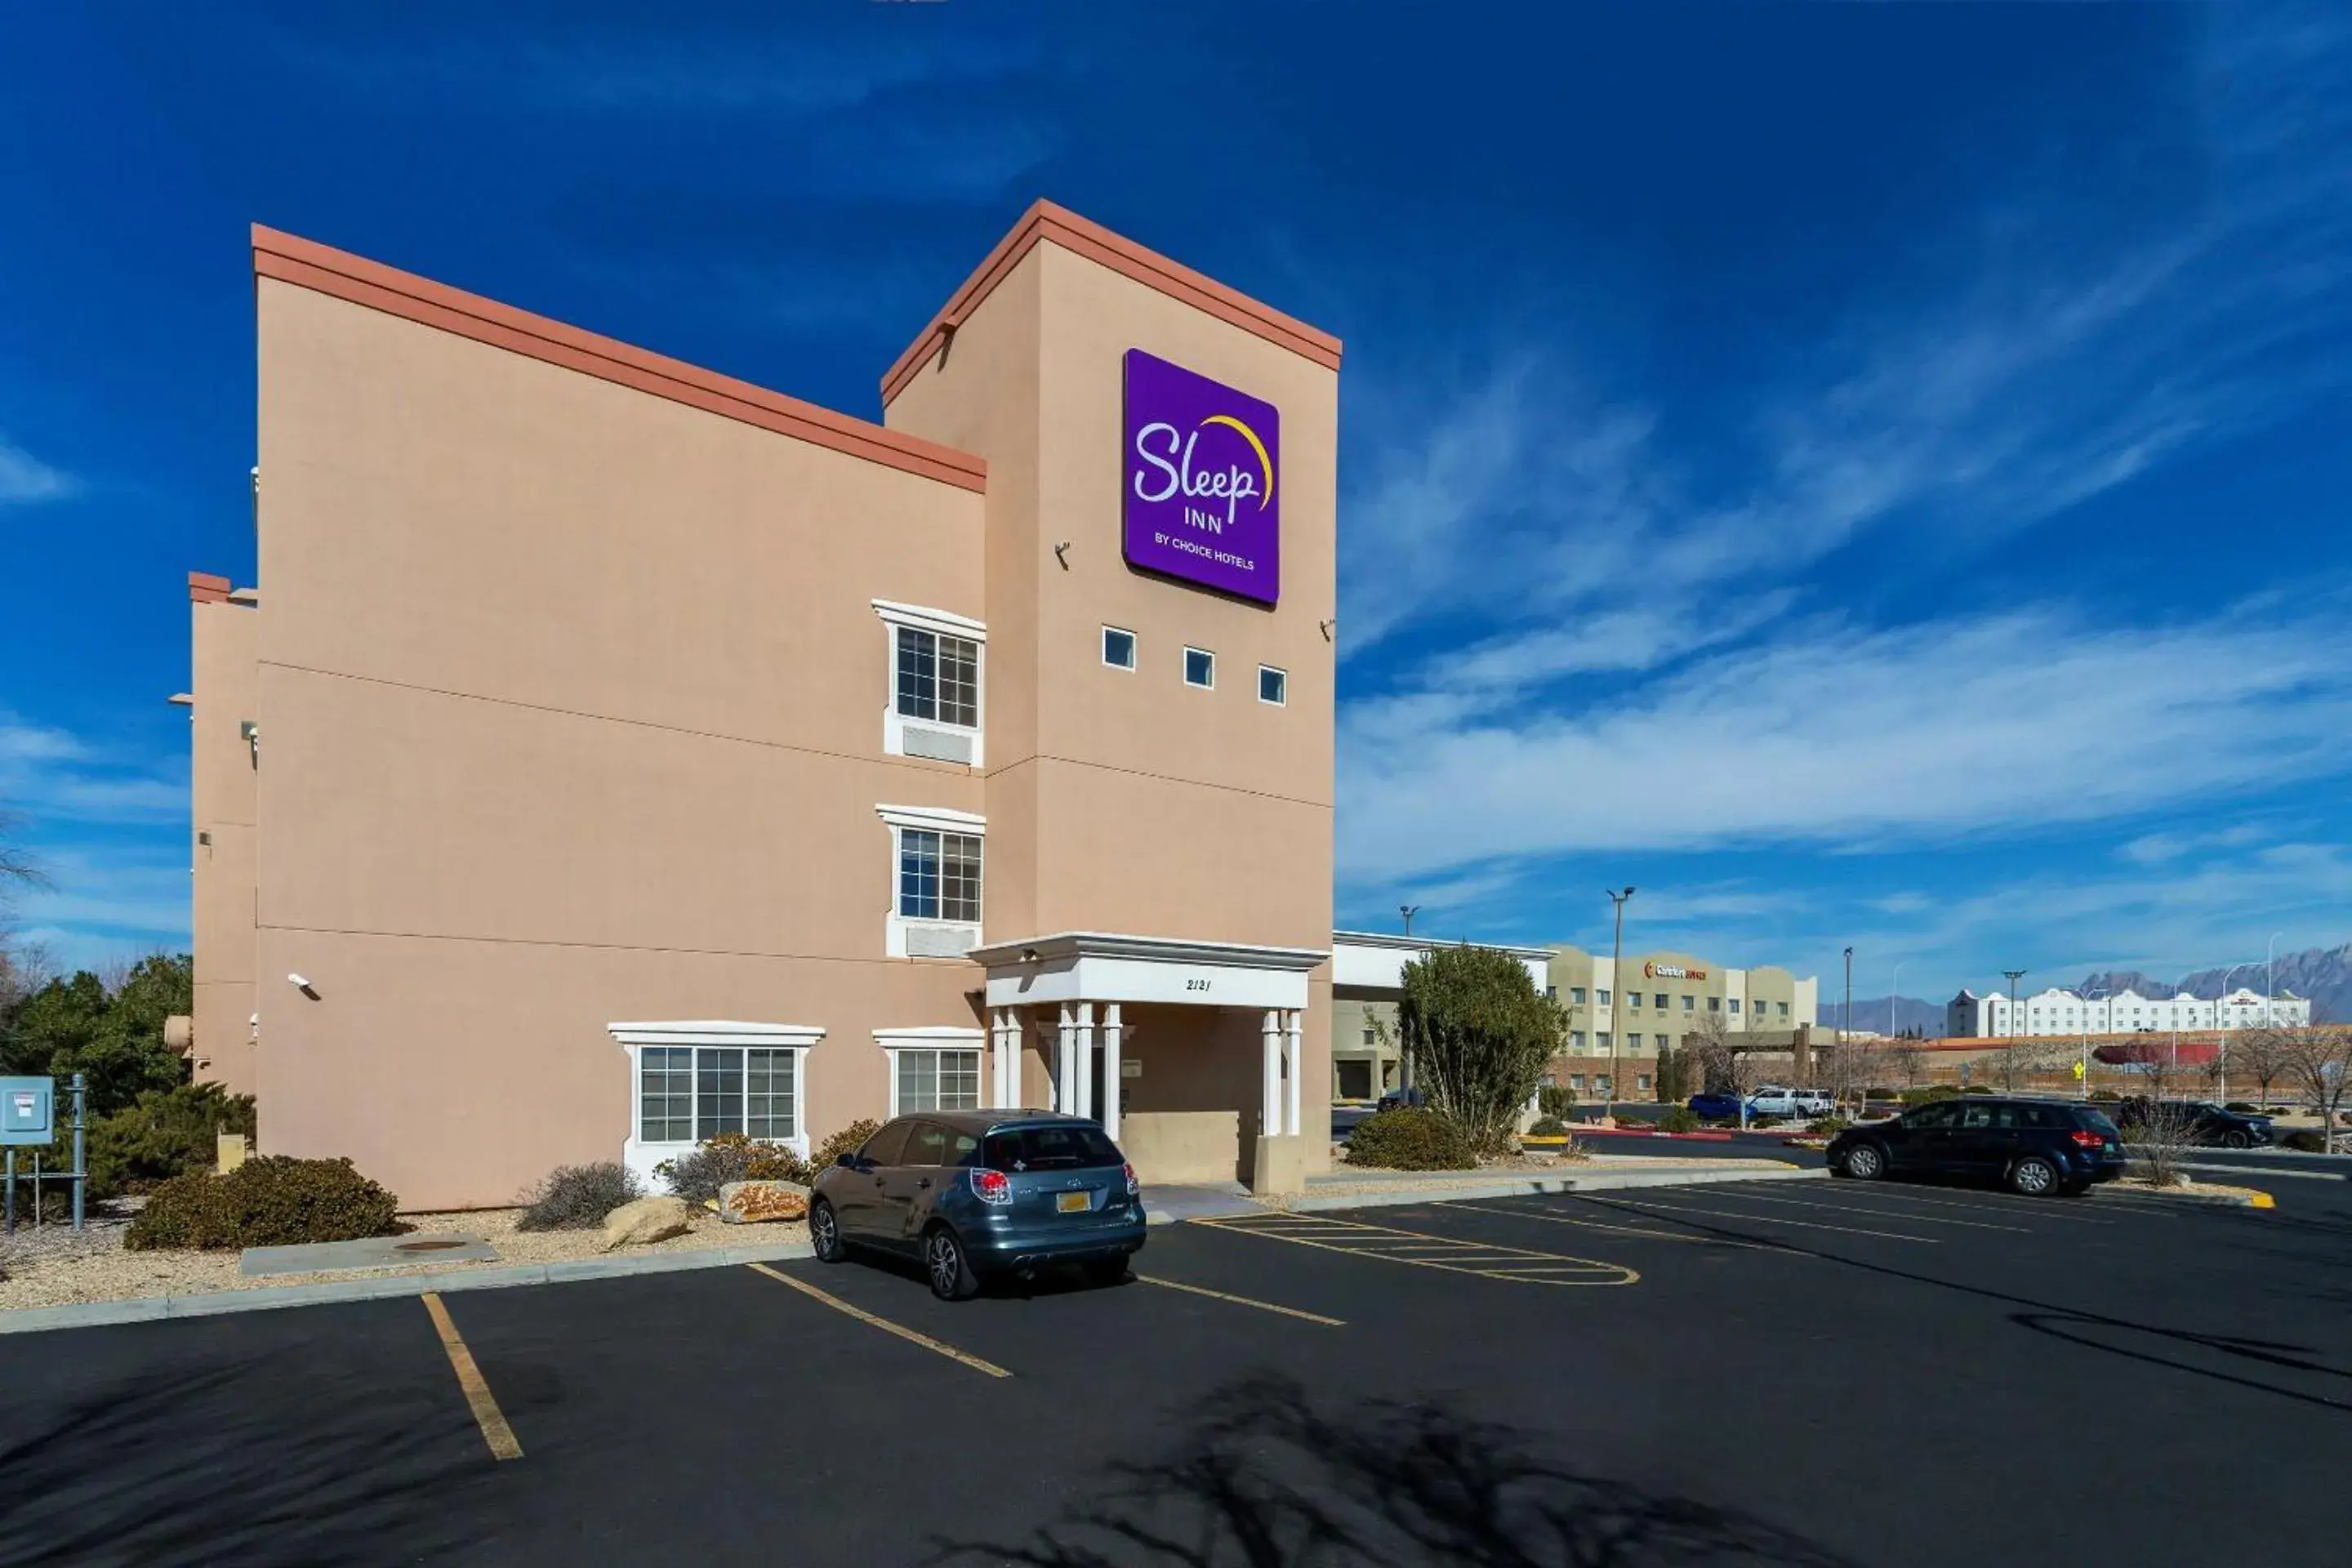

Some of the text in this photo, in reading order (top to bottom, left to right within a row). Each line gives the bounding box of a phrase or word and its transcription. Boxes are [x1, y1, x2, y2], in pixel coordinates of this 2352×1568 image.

[1134, 422, 1259, 524] Sleep
[1184, 506, 1222, 534] INN
[1155, 532, 1254, 570] BY CHOICE HOTELS
[1187, 979, 1211, 991] 2121
